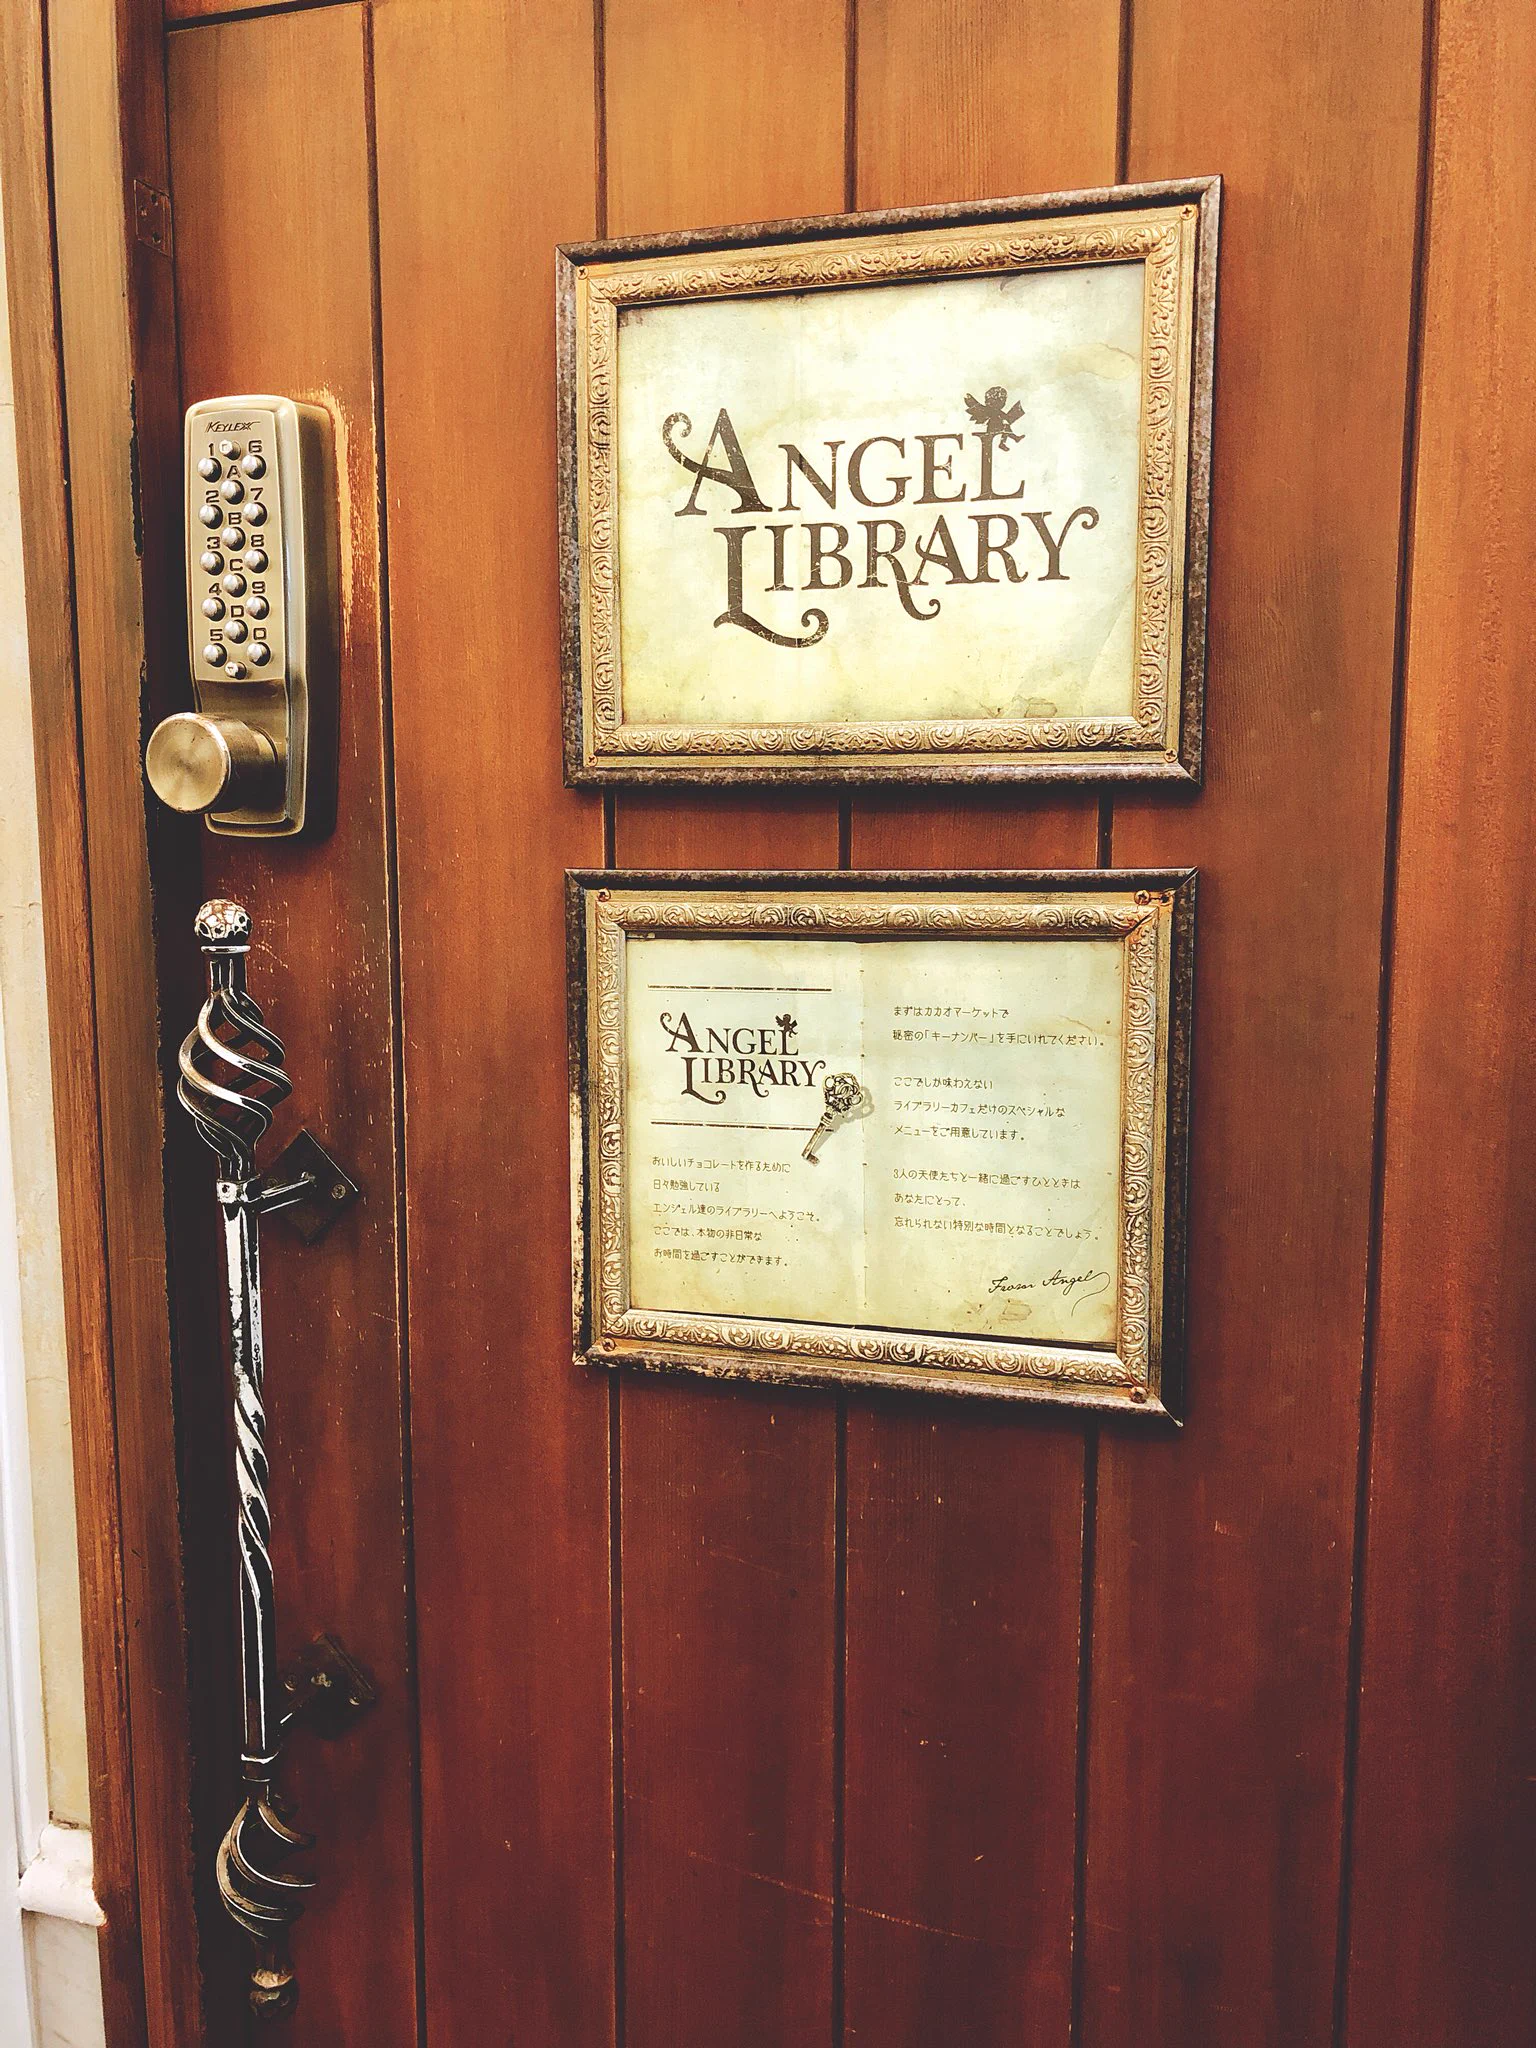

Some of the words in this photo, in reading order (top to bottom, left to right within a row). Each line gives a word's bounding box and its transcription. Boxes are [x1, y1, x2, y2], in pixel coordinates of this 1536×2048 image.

[208, 443, 214, 456] 1
[248, 440, 262, 453] 6
[662, 408, 1025, 516] ANGEL
[227, 465, 241, 478] A
[206, 490, 219, 503] 2
[251, 488, 263, 500] 7
[228, 512, 242, 525] B
[207, 537, 220, 549] 3
[251, 535, 264, 547] 8
[230, 559, 243, 571] C
[714, 506, 1099, 648] LIBRARY
[209, 583, 222, 595] 4
[252, 581, 265, 594] 9
[231, 605, 244, 617] D
[210, 629, 223, 641] 5
[893, 1006, 1009, 1019] まずはカカオマーケットで
[660, 1012, 799, 1055] ANGEL
[681, 1057, 825, 1104] LIBRARY
[893, 1077, 993, 1090] ここでしか味わえない
[893, 1100, 1065, 1117] ライブラリーカフェだけのスペシャルな
[894, 1126, 1025, 1141] メニューをご用意しています。
[652, 1156, 791, 1173] おいしいチョコレートを作るために
[653, 1179, 720, 1192] 日々勉強している
[988, 1276, 1036, 1294] From
